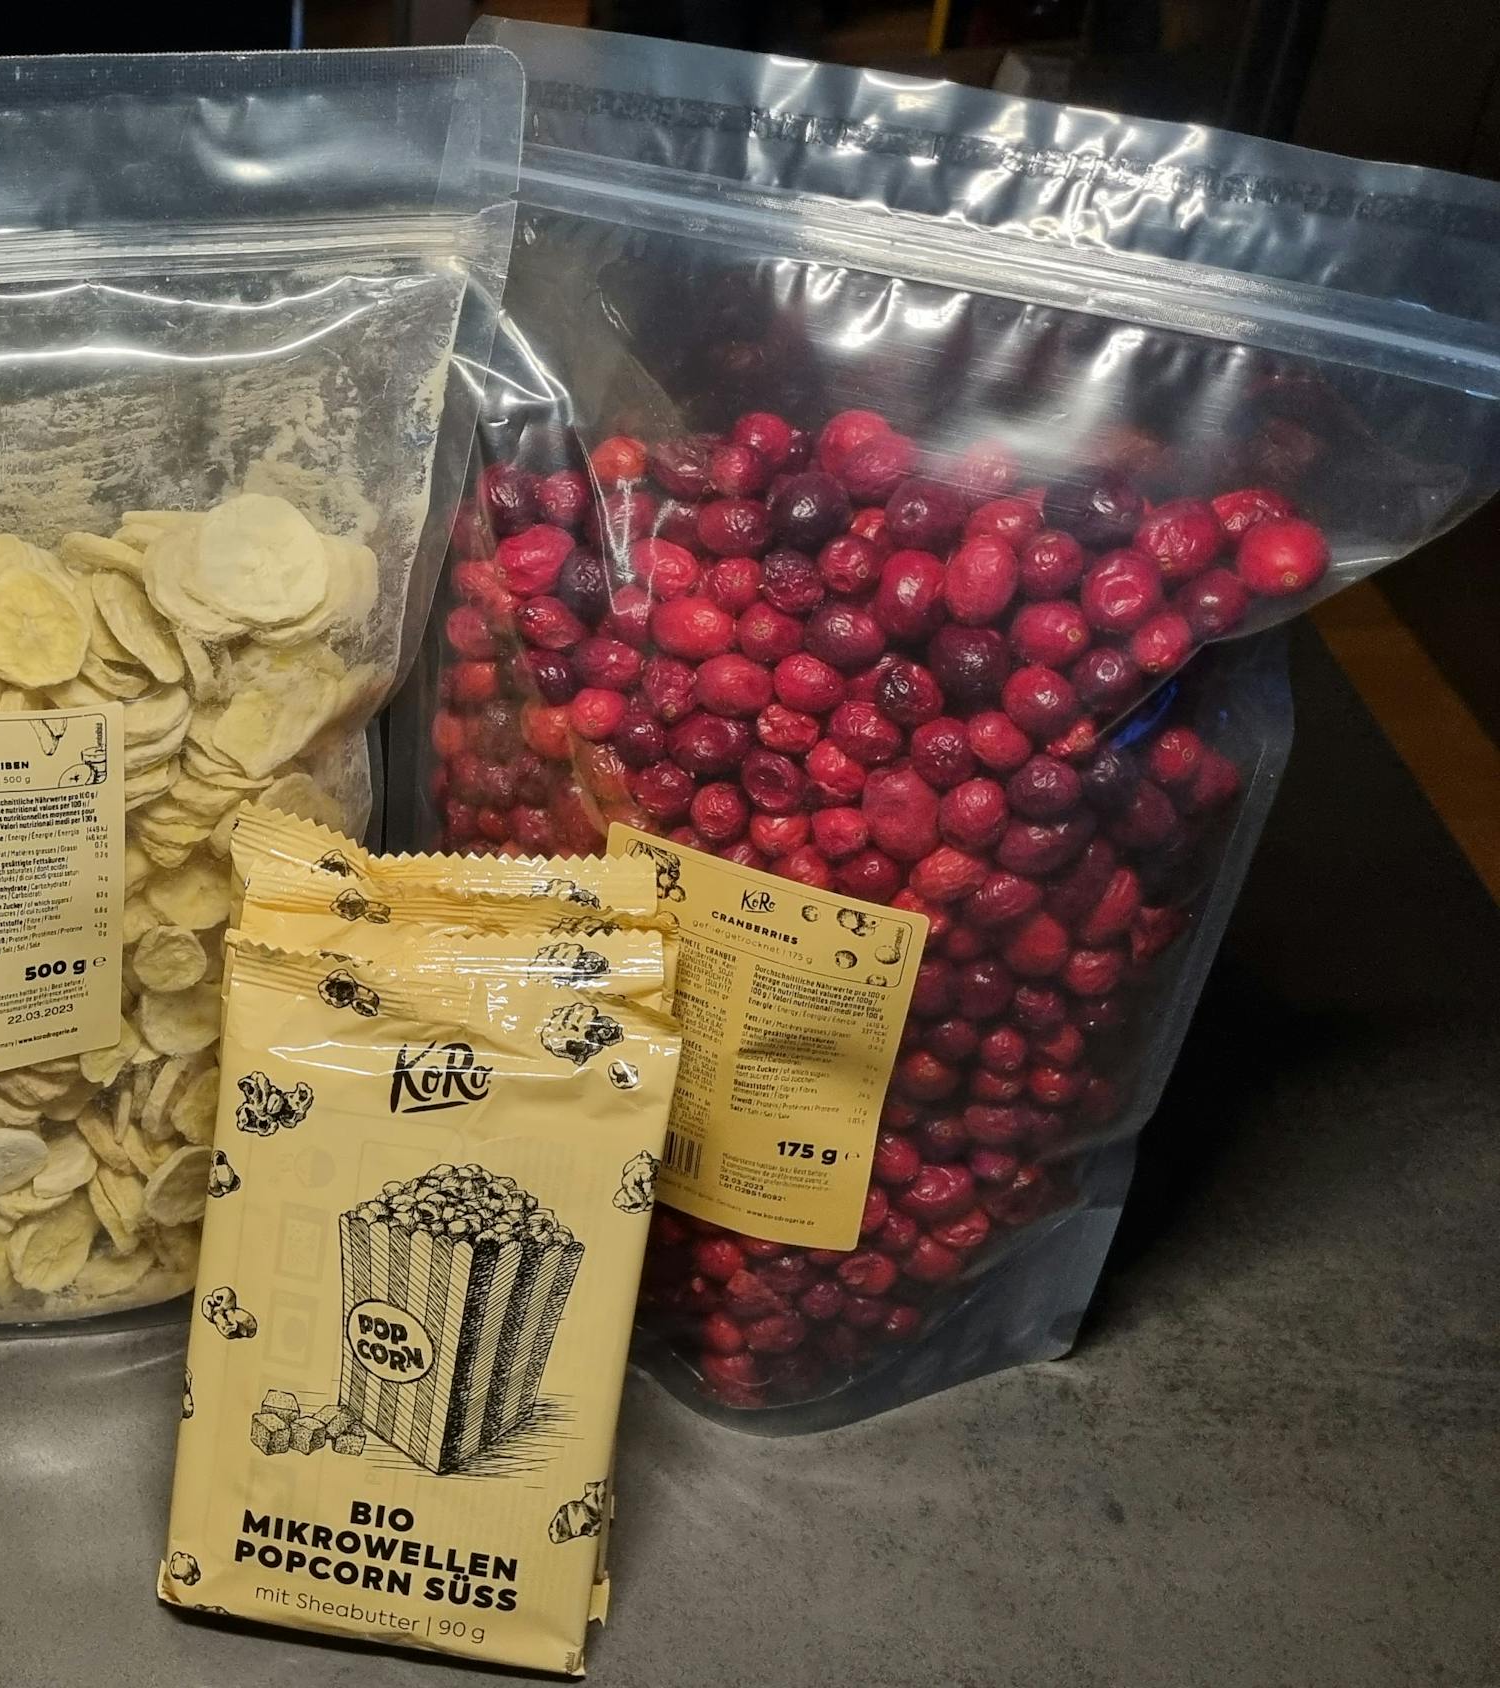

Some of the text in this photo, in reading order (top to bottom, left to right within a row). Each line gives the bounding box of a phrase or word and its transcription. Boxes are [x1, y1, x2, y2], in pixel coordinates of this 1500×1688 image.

[3, 776, 21, 784] 500
[25, 776, 31, 786] g
[6, 804, 38, 814] nutritional
[60, 802, 70, 810] per
[0, 822, 18, 830] Valori
[741, 890, 776, 913] KoRo
[712, 911, 798, 945] CRANBERRIES
[25, 960, 86, 981] 500 g
[755, 964, 814, 986] Durchschnittliche
[752, 980, 776, 992] Valeurs
[778, 987, 828, 1004] nutritionnelles
[754, 972, 780, 986] Average
[781, 981, 818, 994] nutritional
[820, 990, 841, 998] values
[772, 992, 792, 1003] Valori
[7, 1004, 73, 1024] 22.03.2023
[390, 1040, 493, 1114] KoRo
[756, 1064, 779, 1073] Zucker
[778, 1141, 837, 1165] 175 g
[719, 1181, 732, 1191] Lot
[358, 1313, 408, 1346] POP
[357, 1339, 425, 1373] CORN
[350, 1501, 414, 1532] BIO
[242, 1509, 517, 1581] MIKROWELLEN
[235, 1539, 517, 1611] POPCORN SÜSS
[255, 1585, 485, 1644] mit Sheabutter 90 g
